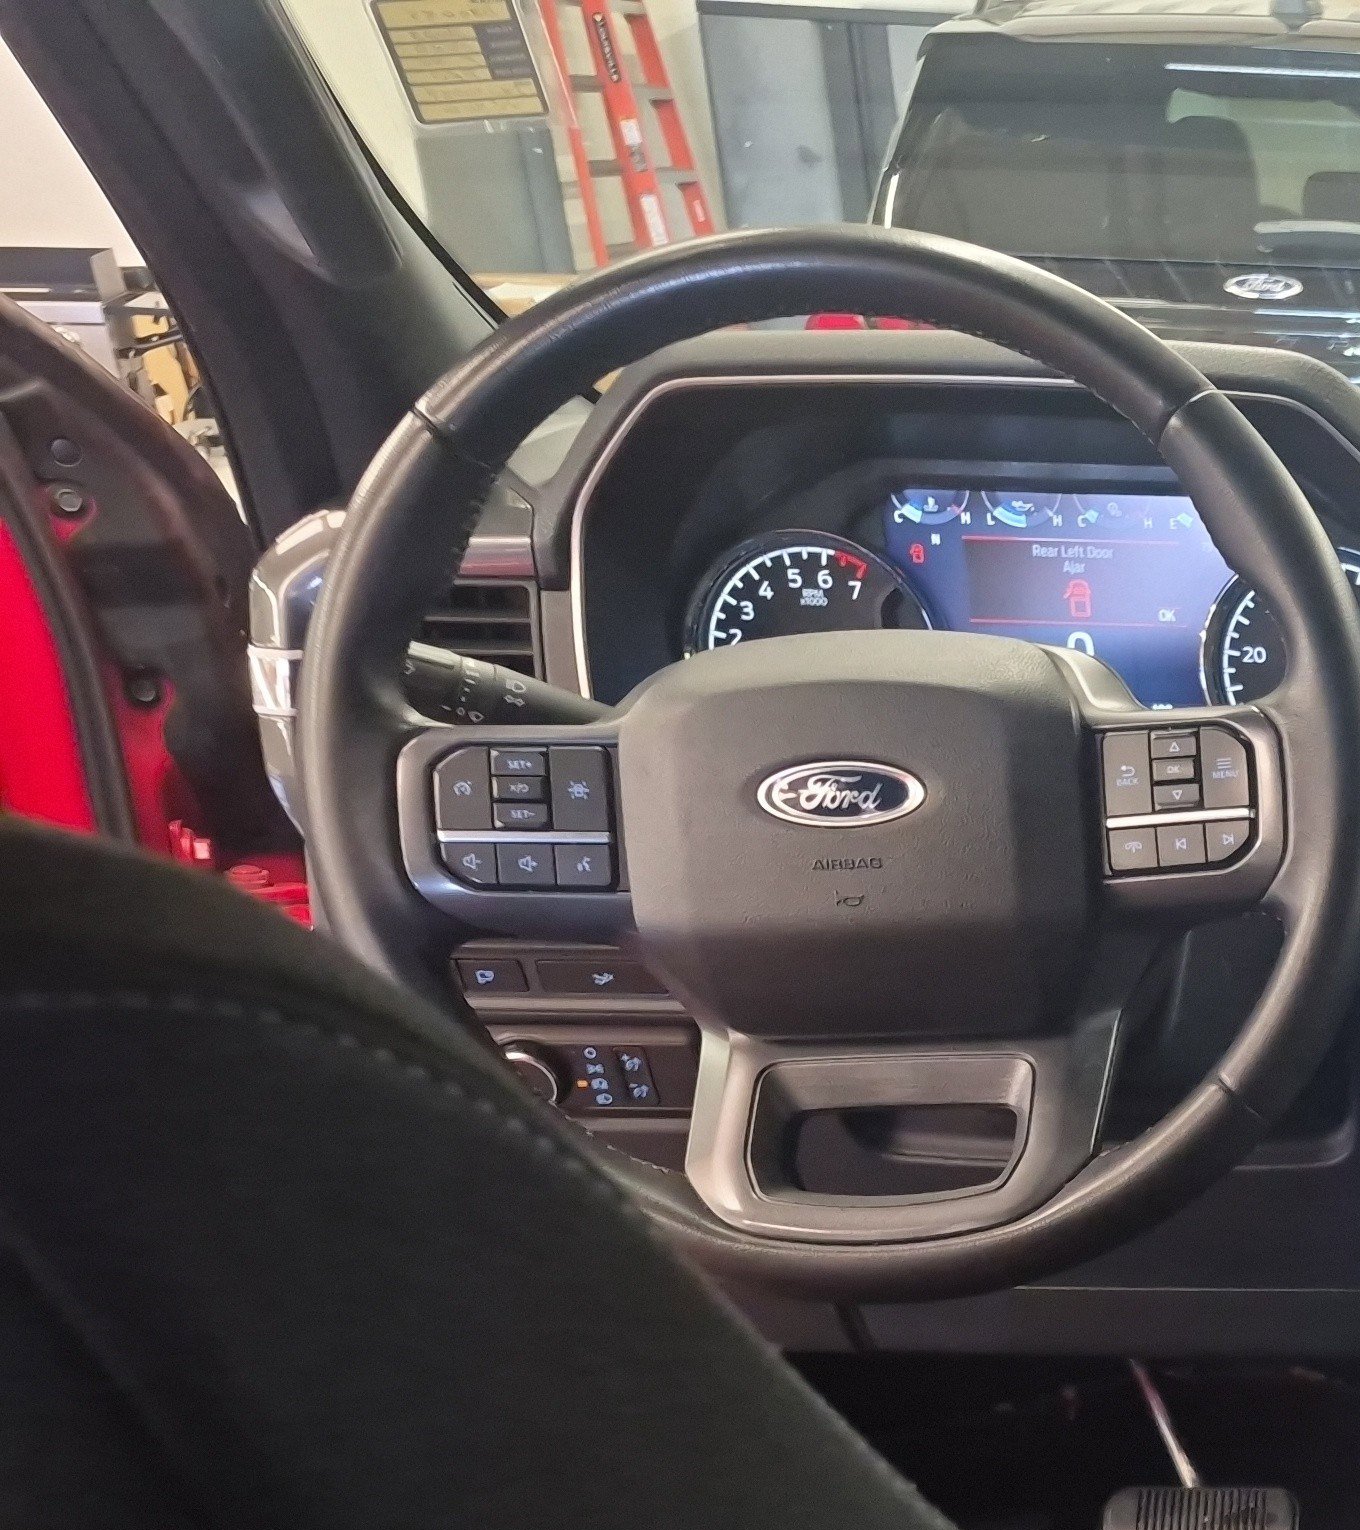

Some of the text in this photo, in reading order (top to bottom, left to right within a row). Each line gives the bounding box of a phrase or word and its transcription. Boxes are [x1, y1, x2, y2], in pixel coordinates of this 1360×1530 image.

[960, 511, 971, 525] H
[1052, 514, 1063, 527] H
[1032, 545, 1114, 559] Rear Left Door
[1063, 561, 1086, 574] Ajar
[787, 568, 802, 589] 5
[817, 569, 833, 590] 6
[758, 580, 775, 600] 4
[848, 580, 862, 600] 7
[739, 601, 755, 621] 3
[1158, 608, 1176, 622] OK
[728, 628, 743, 646] 2
[1242, 646, 1267, 664] 20
[797, 774, 883, 811] Ford
[811, 857, 883, 871] AIRBAG
